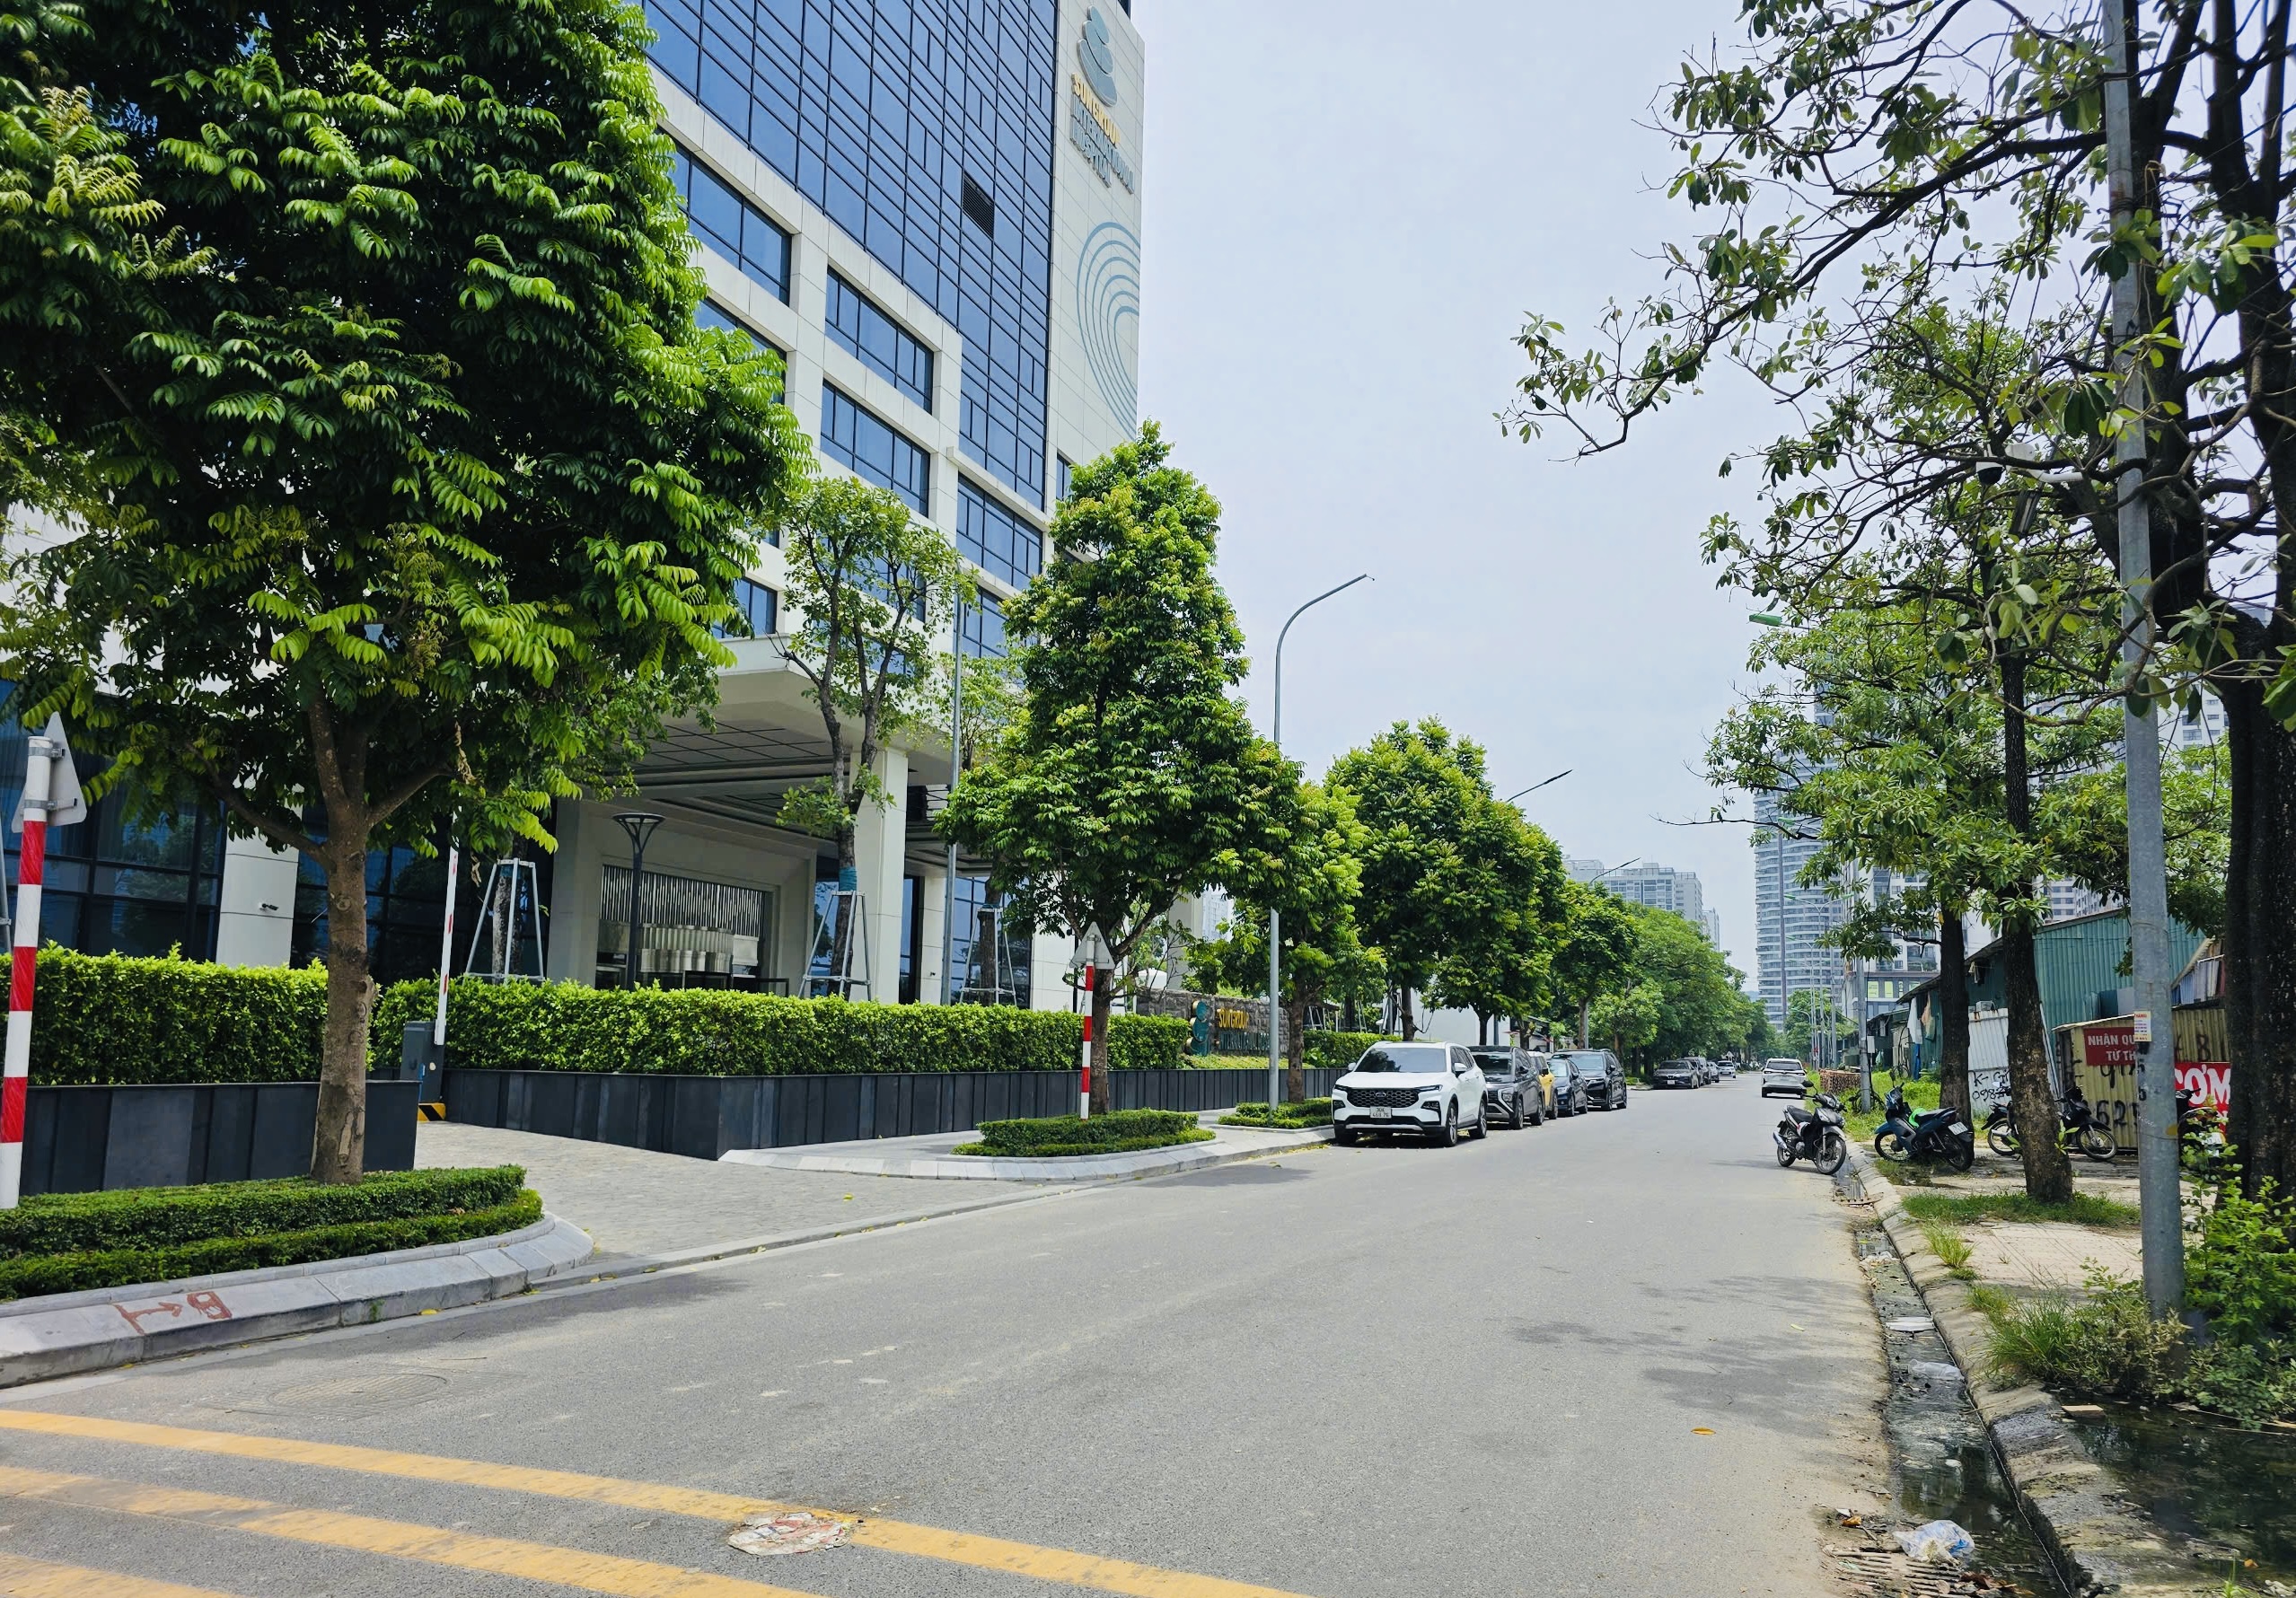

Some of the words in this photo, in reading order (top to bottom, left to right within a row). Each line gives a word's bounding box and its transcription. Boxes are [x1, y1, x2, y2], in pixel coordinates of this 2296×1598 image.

[1069, 117, 1112, 188] HOSPITAL
[1070, 93, 1134, 194] INTERNATIONAL
[2088, 1033, 2118, 1048] NHẬN
[2121, 1034, 2135, 1046] QU
[2106, 1048, 2121, 1061] TỪ
[2123, 1050, 2136, 1061] TH
